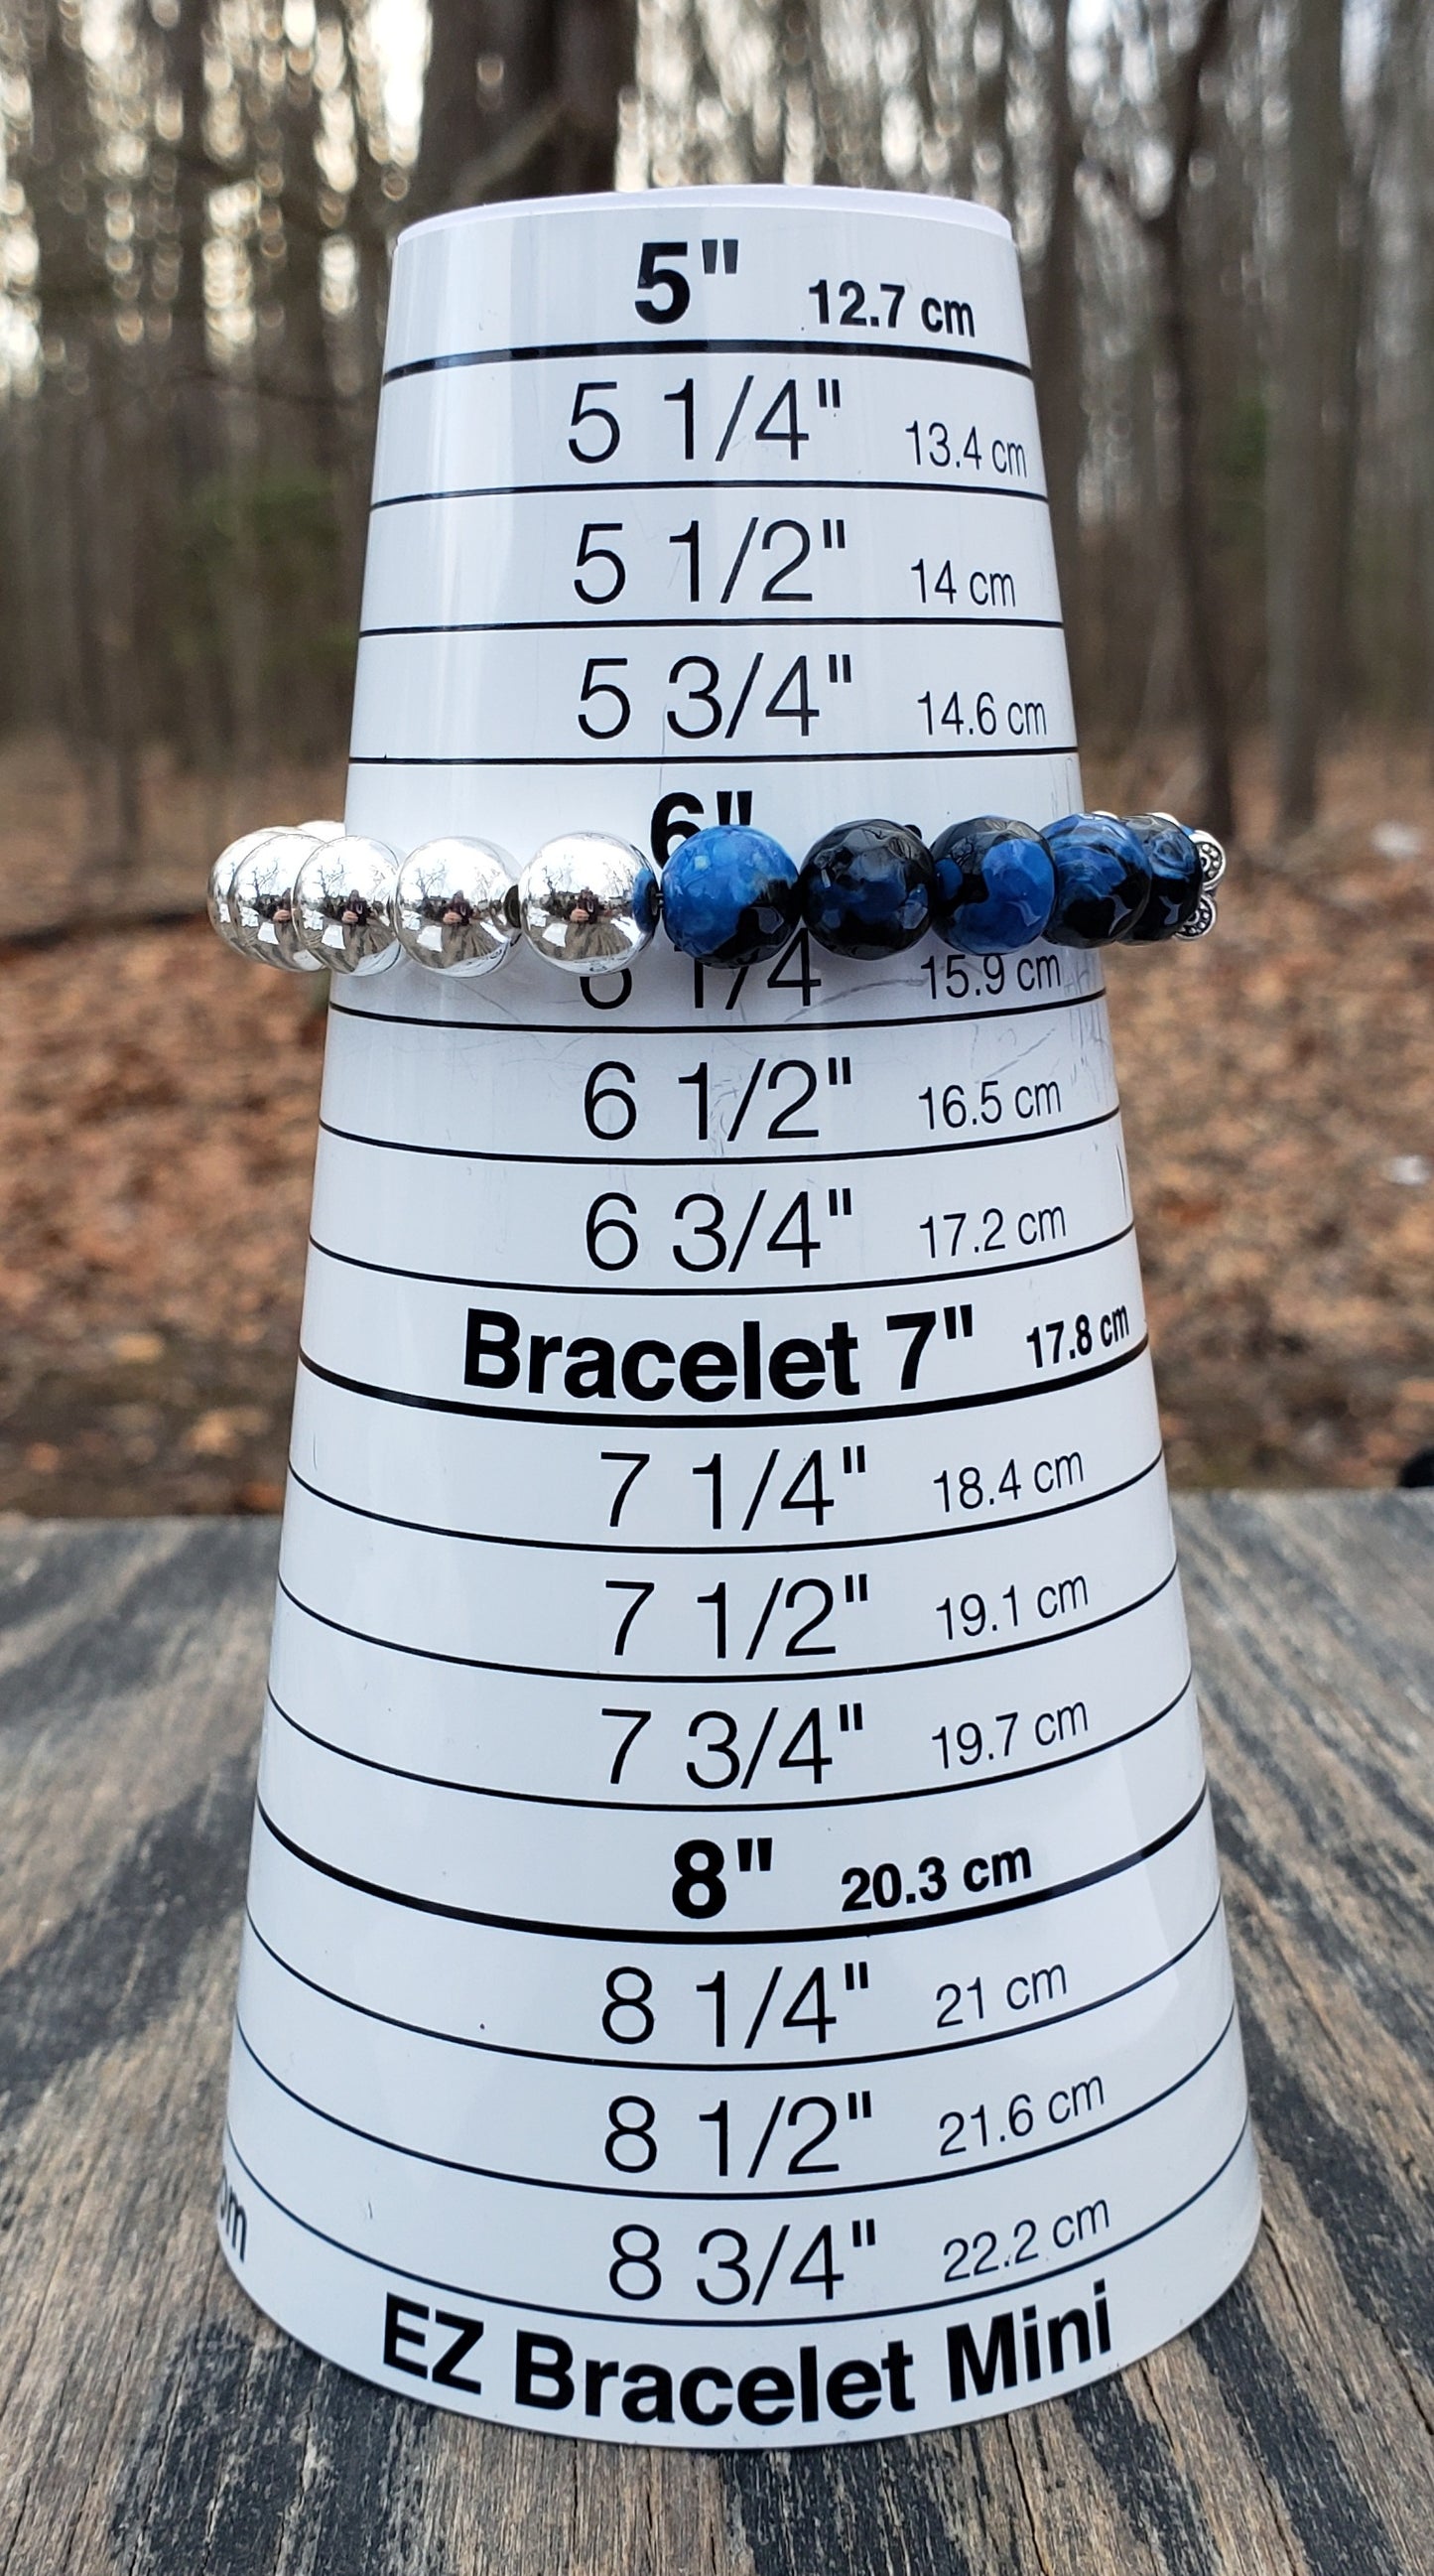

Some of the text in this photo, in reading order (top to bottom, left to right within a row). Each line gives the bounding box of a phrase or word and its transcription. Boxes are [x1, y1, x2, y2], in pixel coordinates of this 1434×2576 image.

[634, 238, 976, 338] 5" 12.7 cm
[568, 374, 1027, 477] 5 1/4" 13.4 cm
[574, 516, 1016, 607] 5 1/2" 14 cm
[578, 652, 1047, 740] 5 3/4" 14.6 cm
[920, 953, 1006, 1001] 15.9
[1016, 953, 1062, 991] cm
[584, 1056, 1062, 1143] 6 1/2" 16.5 cm
[586, 1187, 1067, 1273] 6 3/4" 17.2 cm
[463, 1303, 1129, 1403] Bracelet 7" 17.8 cm
[600, 1444, 1084, 1532] 7 1/4" 18.4 cm
[605, 1572, 1089, 1661] 7 1/2" 19.1 cm
[601, 1701, 1089, 1790] 7 3/4" 19.7 cm
[671, 1836, 1032, 1920] 8" 20.3 cm
[601, 1961, 1067, 2050] 8 1/4" 21 cm
[604, 2076, 1105, 2179] 8 1/2" 21.6 cm
[608, 2199, 1109, 2306] 8 3/4" 22.2 cm
[382, 2277, 1111, 2427] EZ Bracelet Mini
